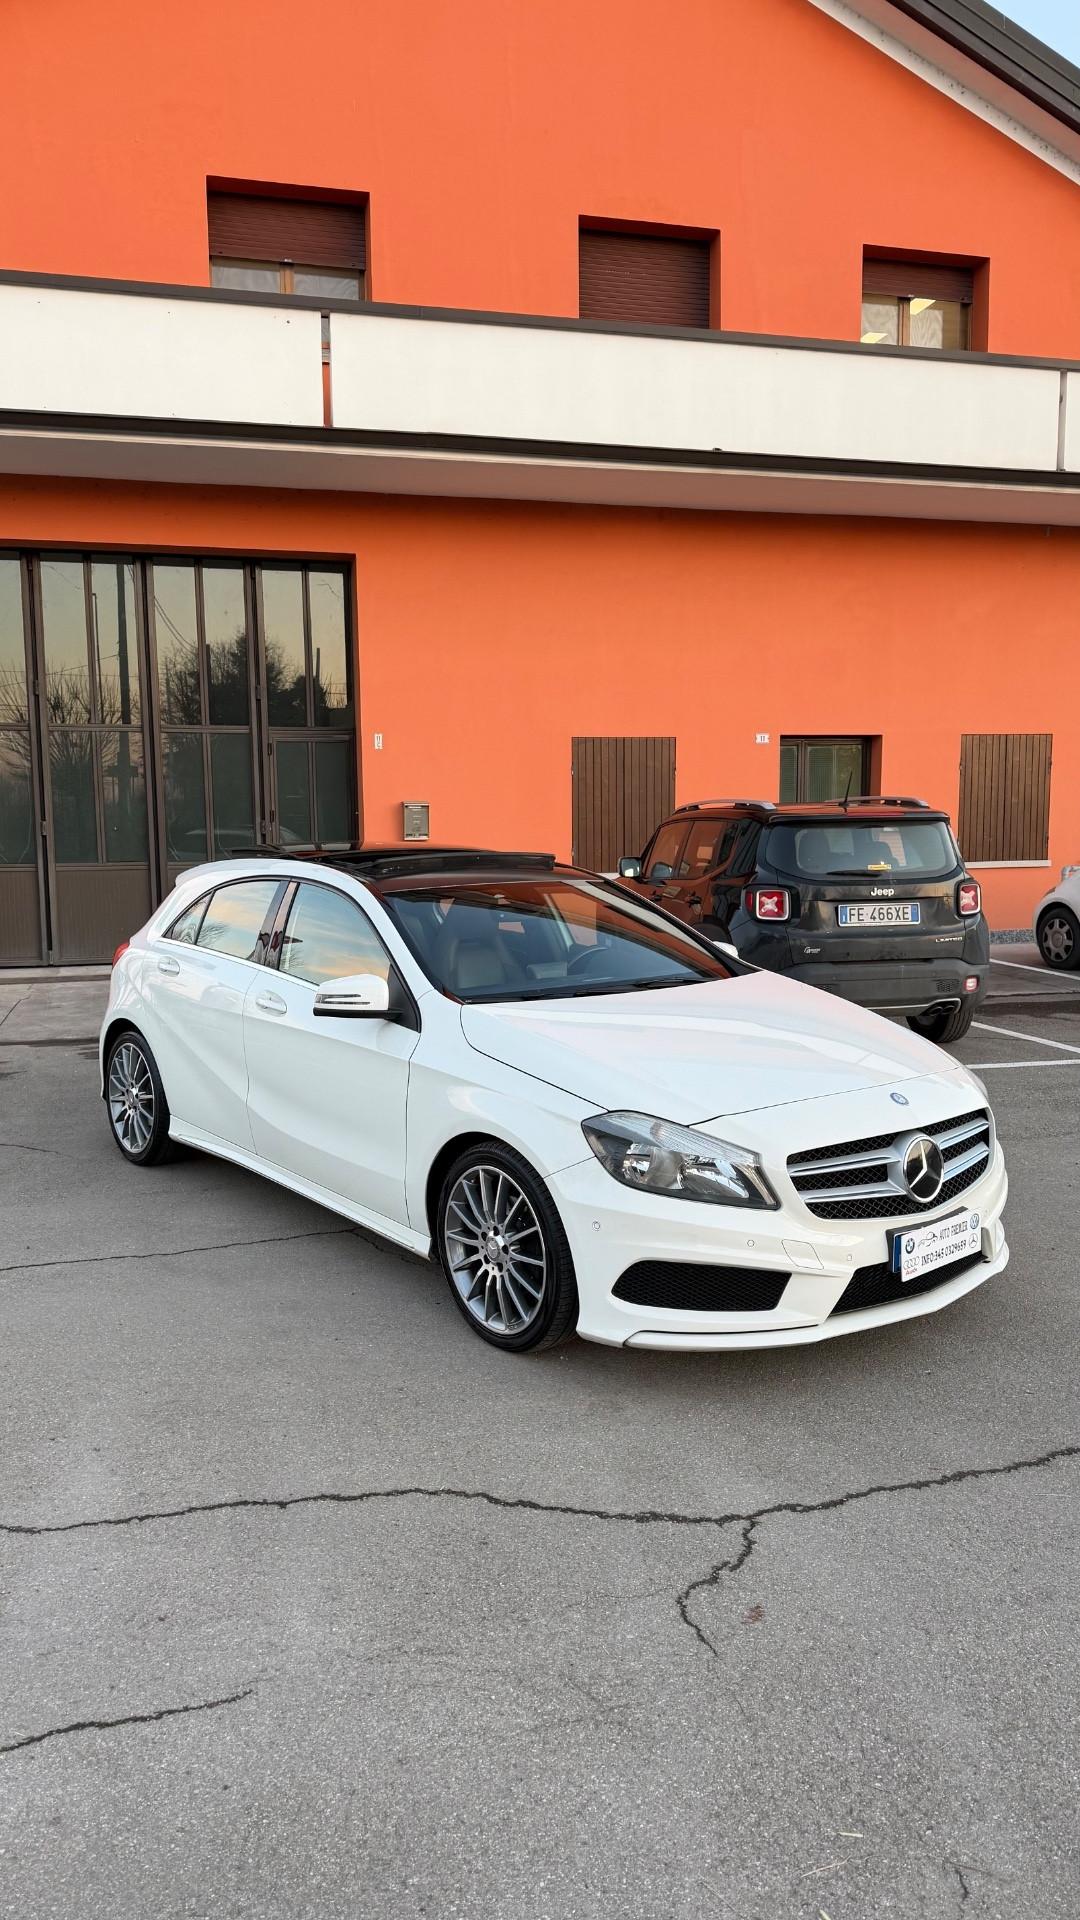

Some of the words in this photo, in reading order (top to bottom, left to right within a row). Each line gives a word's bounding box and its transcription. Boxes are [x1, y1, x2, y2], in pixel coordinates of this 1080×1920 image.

[870, 887, 895, 897] Jeep
[849, 907, 865, 922] FE
[870, 906, 910, 921] 466XE
